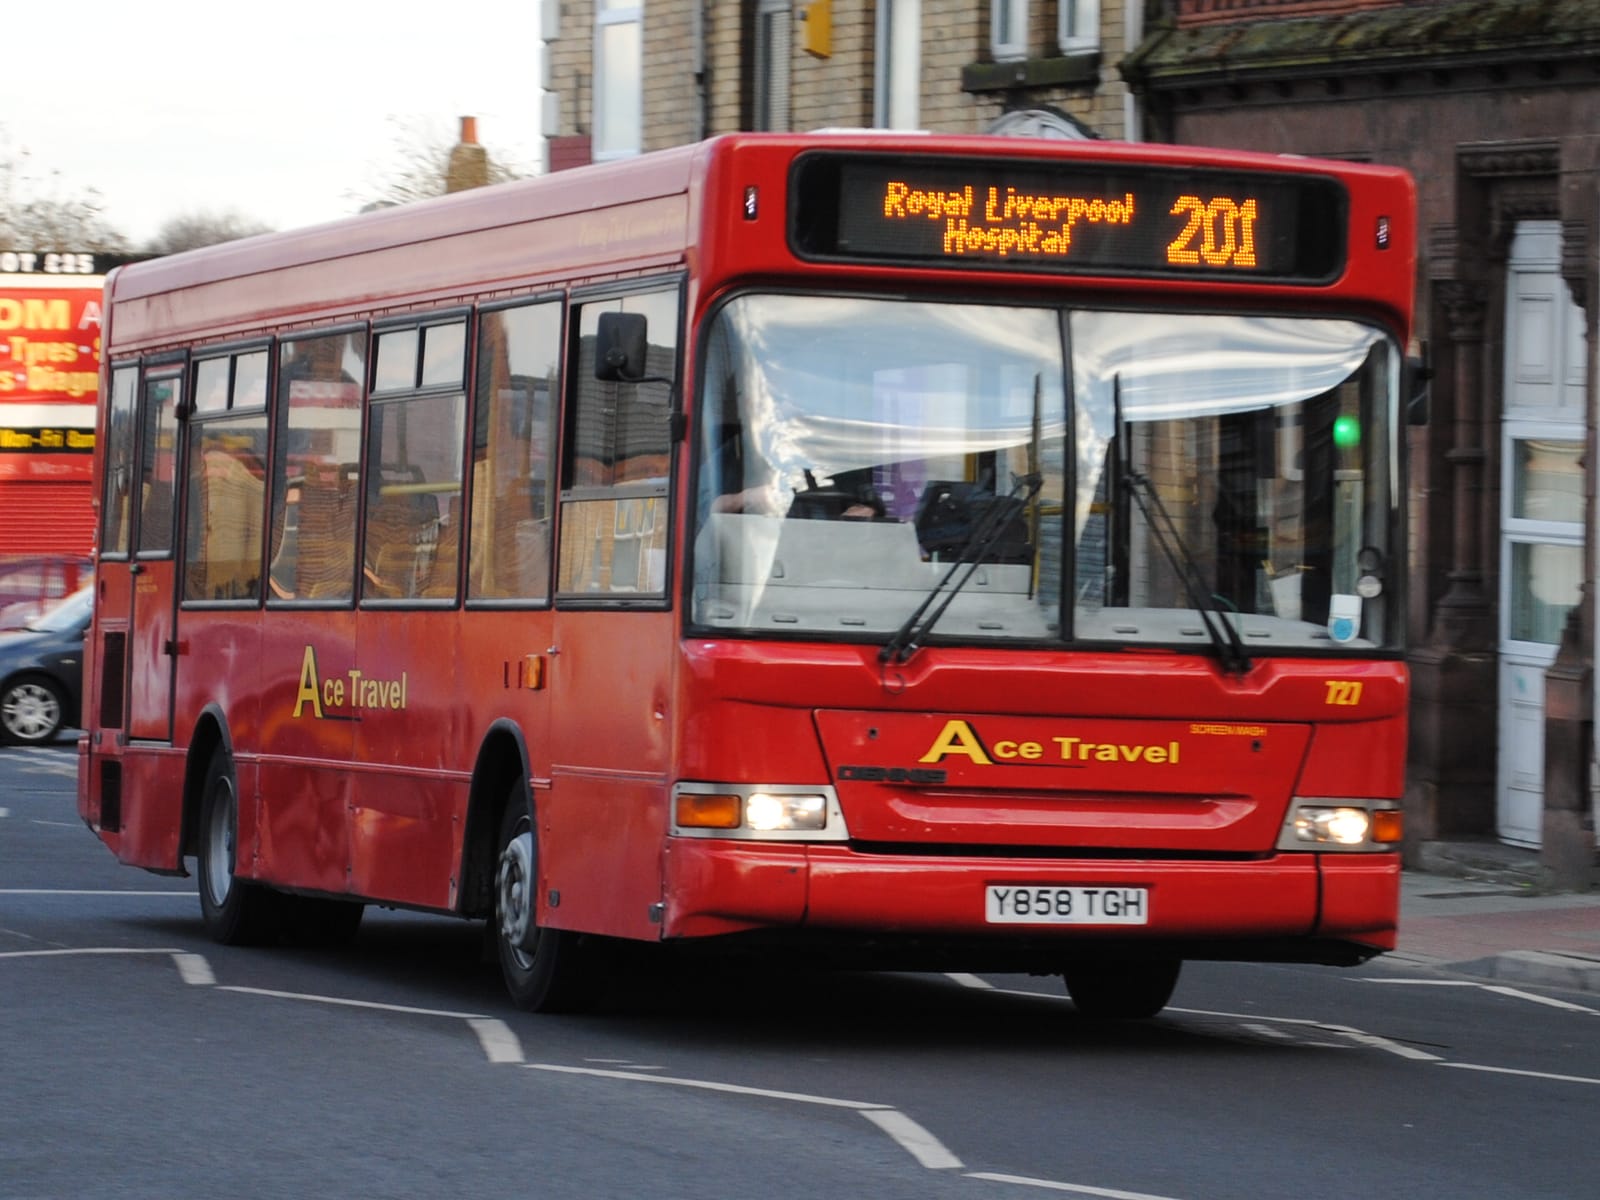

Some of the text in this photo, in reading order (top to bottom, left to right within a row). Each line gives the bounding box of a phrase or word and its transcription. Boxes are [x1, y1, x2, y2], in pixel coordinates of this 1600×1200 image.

[885, 181, 1134, 224] Royal Liverpool
[943, 218, 1071, 255] Hospital
[1167, 195, 1257, 267] 201
[292, 645, 407, 718] Ace Travel
[918, 719, 1180, 765] Ace Travel
[993, 888, 1142, 917] Y858 TGH
